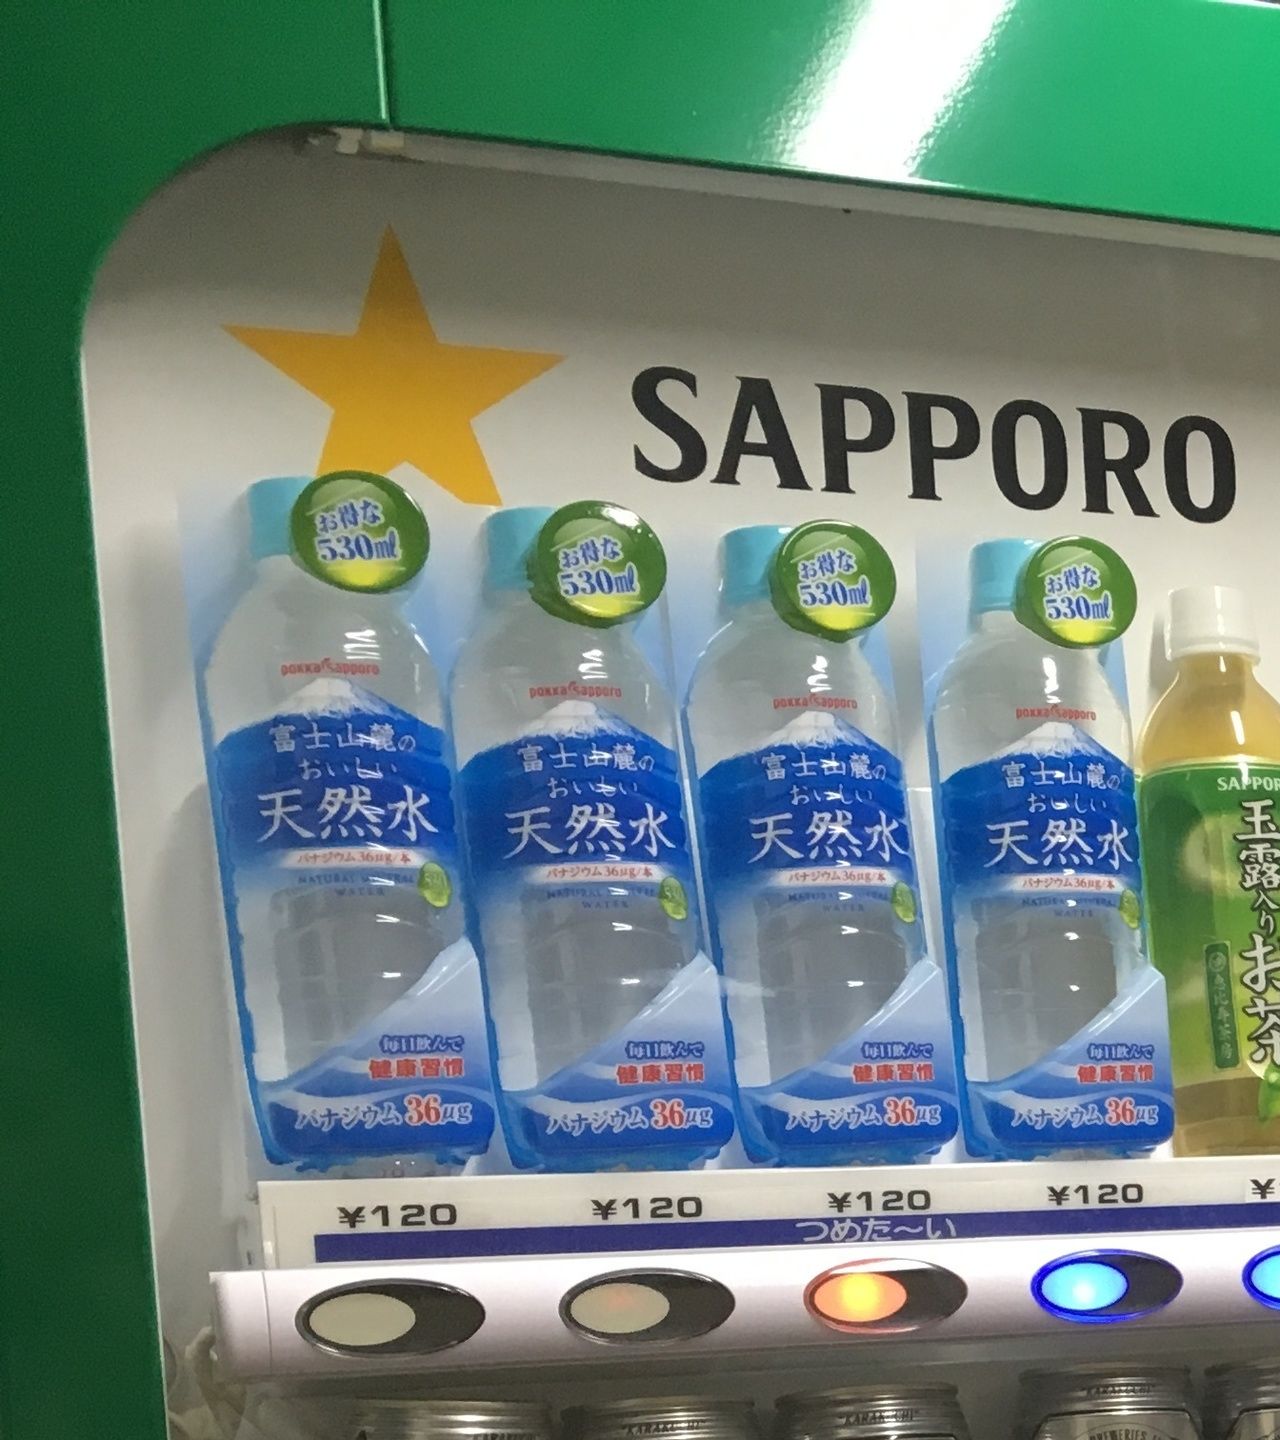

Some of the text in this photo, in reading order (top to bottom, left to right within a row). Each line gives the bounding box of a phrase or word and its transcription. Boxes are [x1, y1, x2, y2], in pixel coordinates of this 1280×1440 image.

[630, 365, 1237, 524] SAPPORO
[318, 502, 382, 534] お得な
[561, 538, 622, 568] お得な
[799, 551, 855, 578] お得な
[1045, 567, 1098, 594] お得な
[257, 788, 438, 843] 天然水
[504, 803, 676, 857] 天然水
[748, 814, 906, 864] 天然水
[984, 820, 1133, 868] 天然水
[369, 1059, 464, 1080] 健康習慣
[616, 1064, 705, 1085] 健康習慣
[852, 1064, 934, 1083] 健康習慣
[1077, 1064, 1154, 1083] 健康習慣
[592, 1196, 703, 1220] ¥120
[829, 1189, 931, 1212] ¥120
[1048, 1183, 1144, 1206] ¥120
[338, 1204, 457, 1229] ¥120
